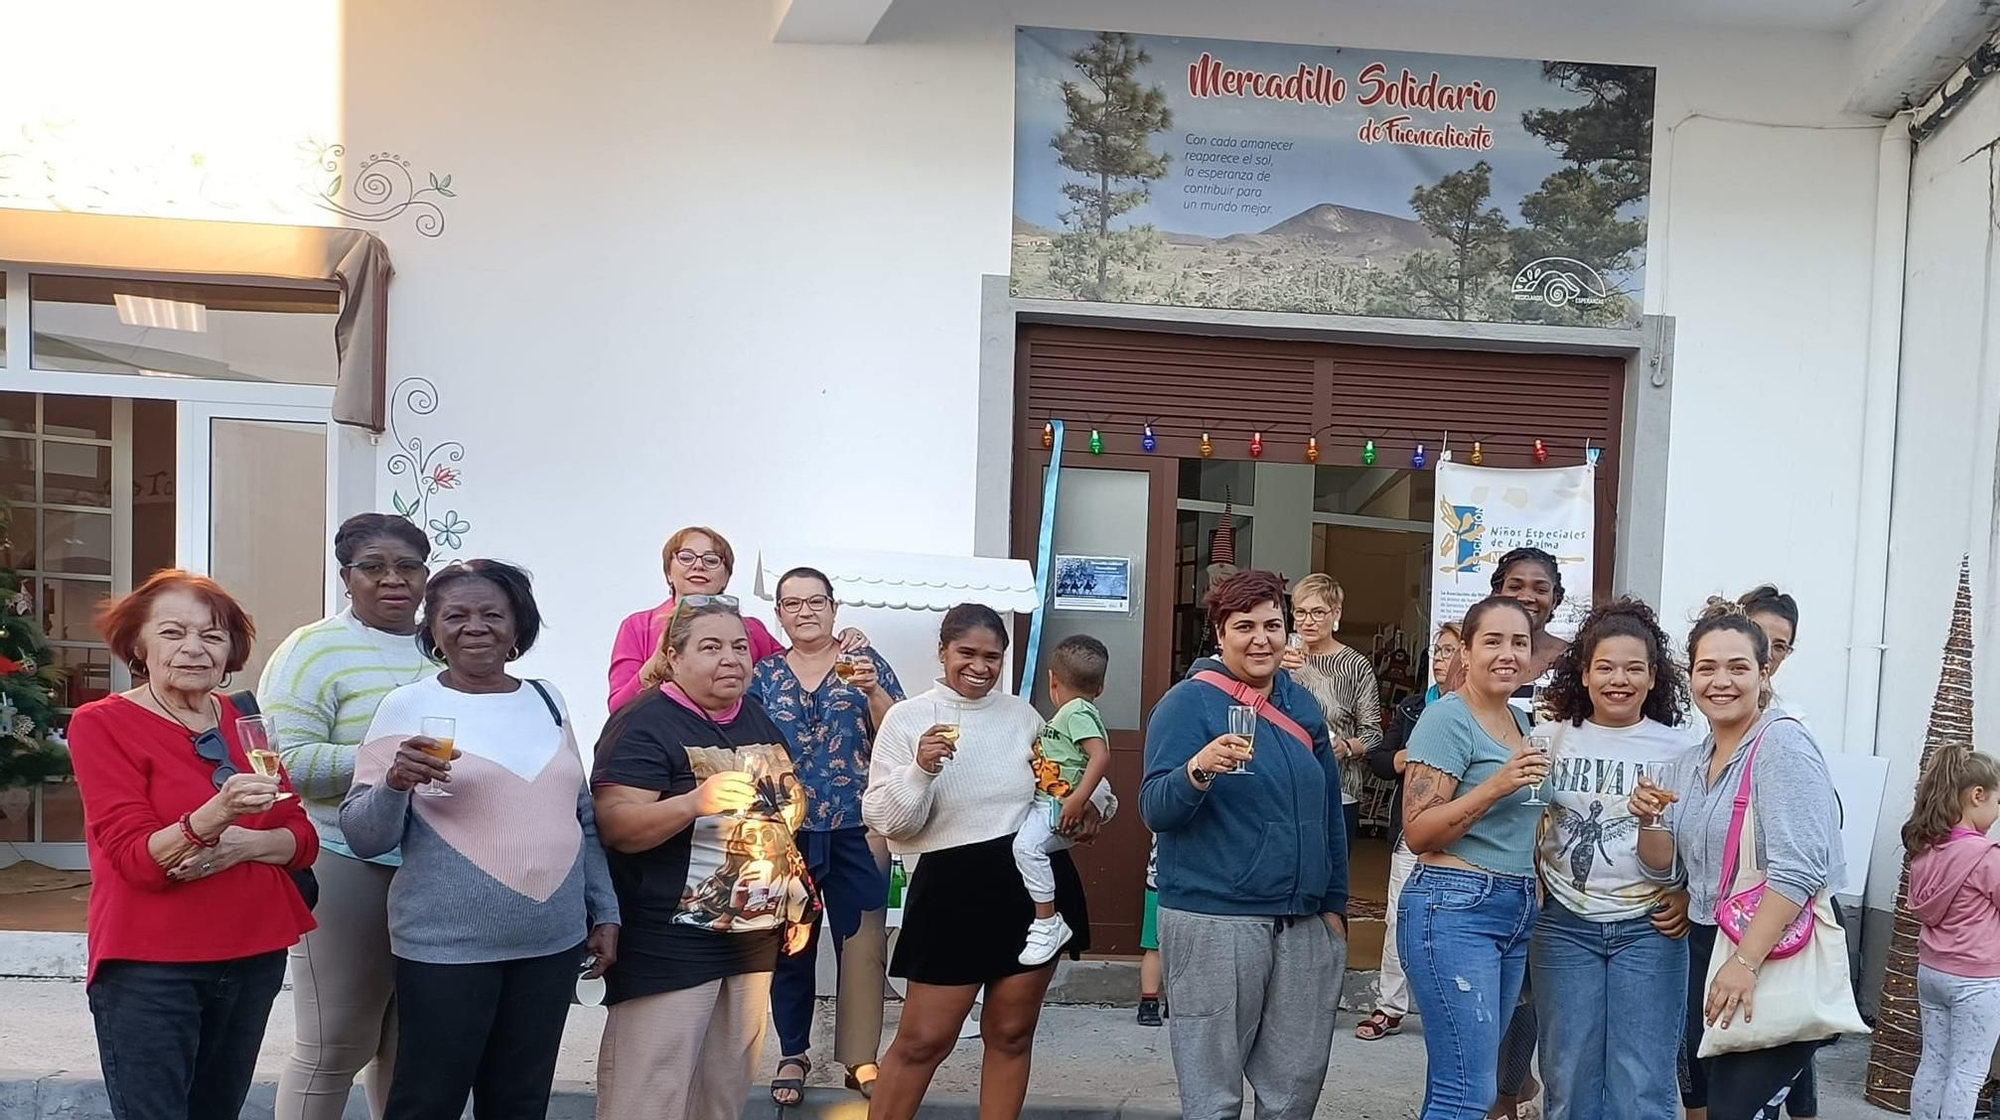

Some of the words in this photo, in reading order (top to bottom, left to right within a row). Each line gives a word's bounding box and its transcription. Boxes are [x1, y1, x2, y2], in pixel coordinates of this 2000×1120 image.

[1190, 53, 1346, 106] Mercadillo
[1357, 63, 1497, 113] Solidario
[1359, 118, 1382, 144] de
[1383, 116, 1494, 150] Fuencaliente
[1185, 133, 1207, 146] Con
[1210, 136, 1237, 148] cada
[1240, 138, 1294, 151] amanecer
[1184, 151, 1240, 164] reaparece
[1242, 154, 1253, 165] el
[1184, 166, 1194, 177] la
[1197, 168, 1254, 181] esperanza
[1256, 170, 1271, 182] de
[1183, 184, 1234, 196] contribuir
[1236, 187, 1262, 199] para
[1183, 200, 1197, 210] un
[1200, 201, 1238, 213] mundo
[1490, 526, 1522, 538] Niños
[1525, 528, 1587, 541] Especiales
[1491, 538, 1504, 548] de
[1508, 539, 1521, 548] La
[1525, 539, 1560, 550] Palma
